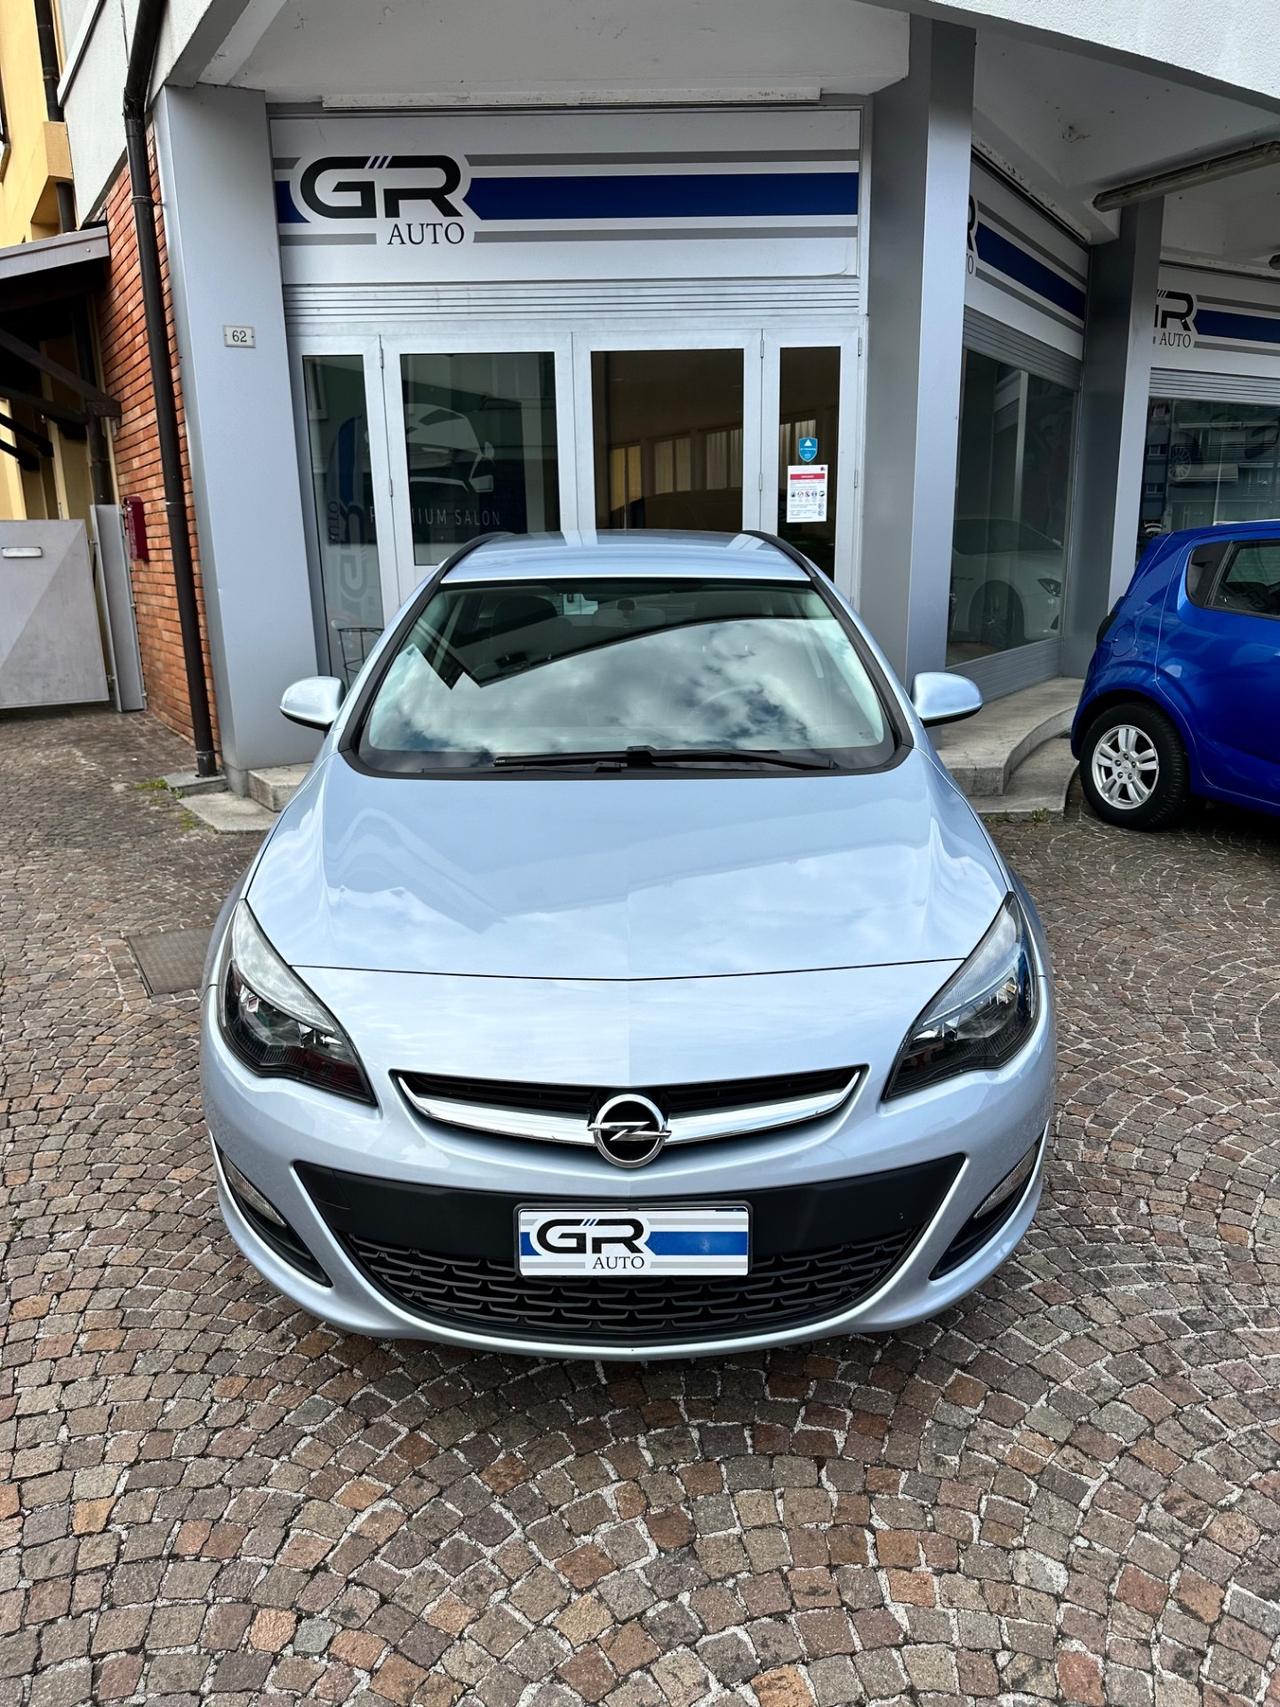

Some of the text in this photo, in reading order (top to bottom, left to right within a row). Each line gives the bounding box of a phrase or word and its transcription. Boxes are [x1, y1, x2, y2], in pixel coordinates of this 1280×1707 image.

[300, 154, 464, 219] GR
[387, 222, 465, 245] AUTO
[1153, 289, 1194, 332] R
[232, 329, 248, 343] 62
[1159, 332, 1192, 349] AUTO
[454, 508, 501, 527] SALON
[536, 1218, 645, 1254] GR
[592, 1256, 645, 1270] AUTO
